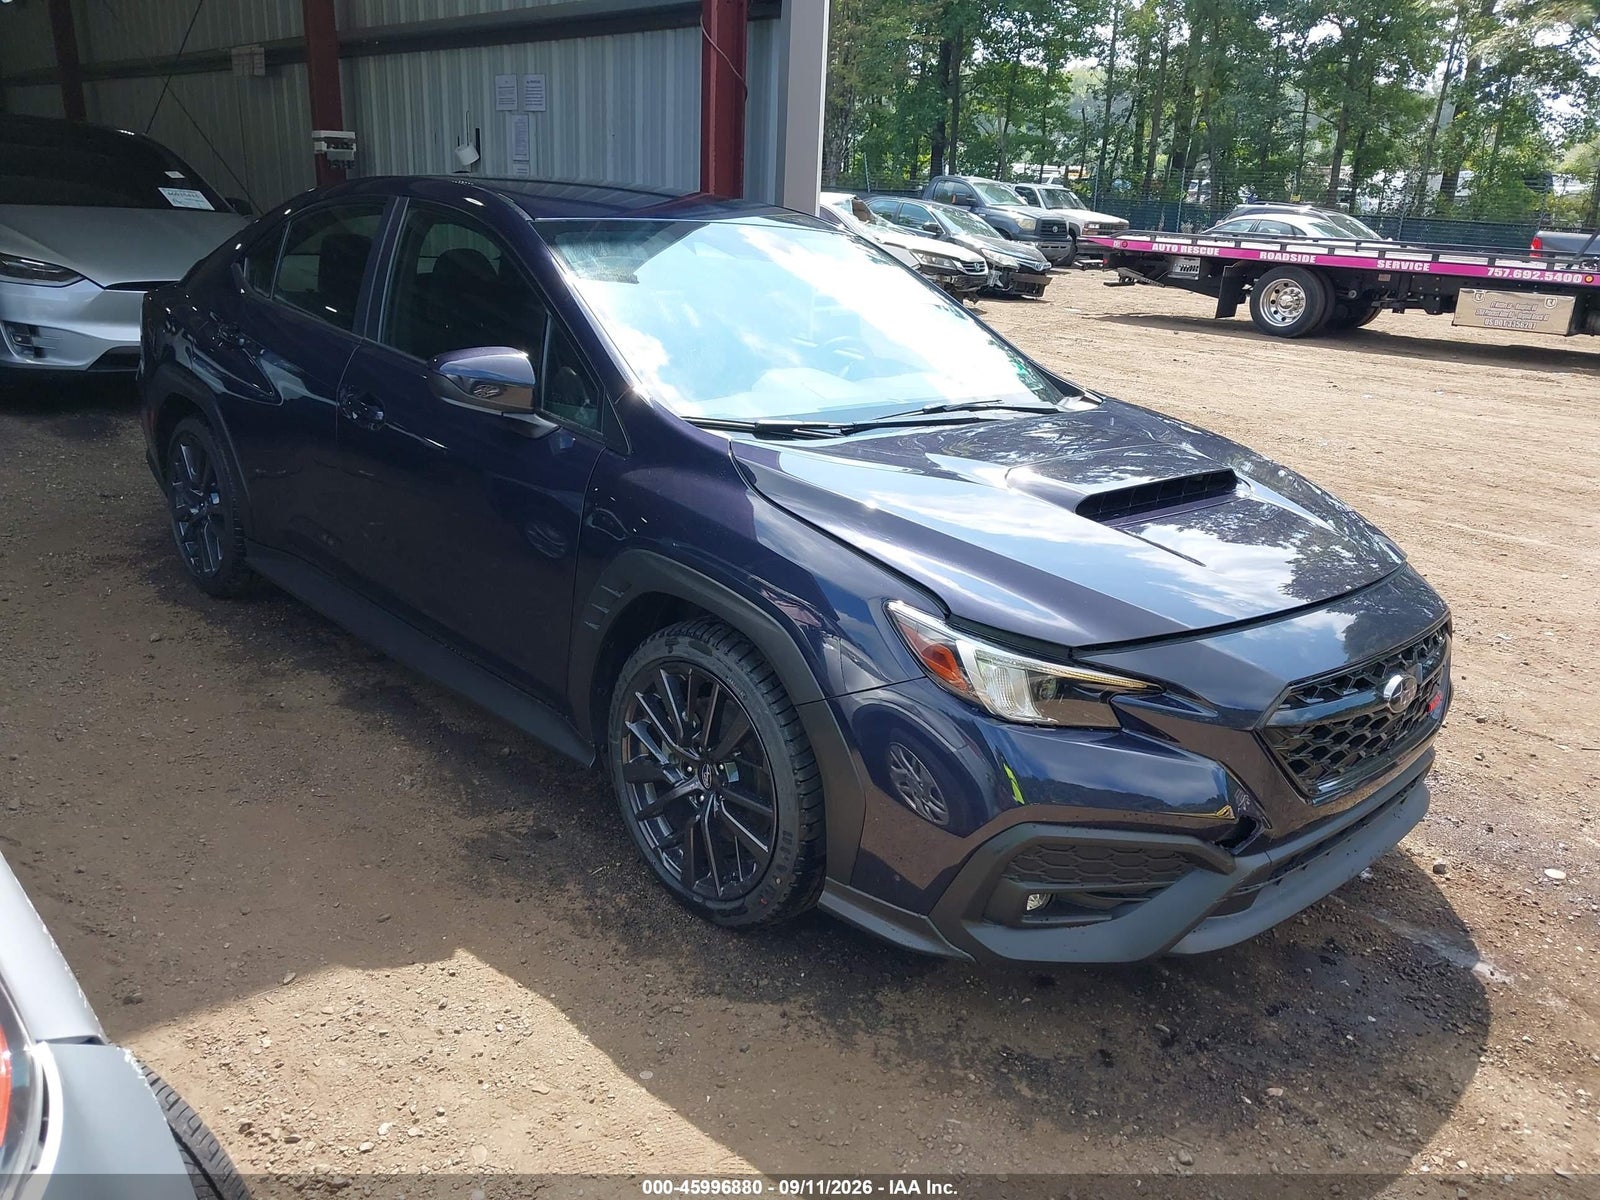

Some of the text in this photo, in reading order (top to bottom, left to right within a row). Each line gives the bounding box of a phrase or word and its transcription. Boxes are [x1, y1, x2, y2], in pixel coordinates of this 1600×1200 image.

[1152, 243, 1220, 256] AUTO RESCUE
[1259, 251, 1316, 263] ROADSIDE
[1377, 260, 1430, 272] SERVICE
[1487, 267, 1583, 283] 757.692.5400
